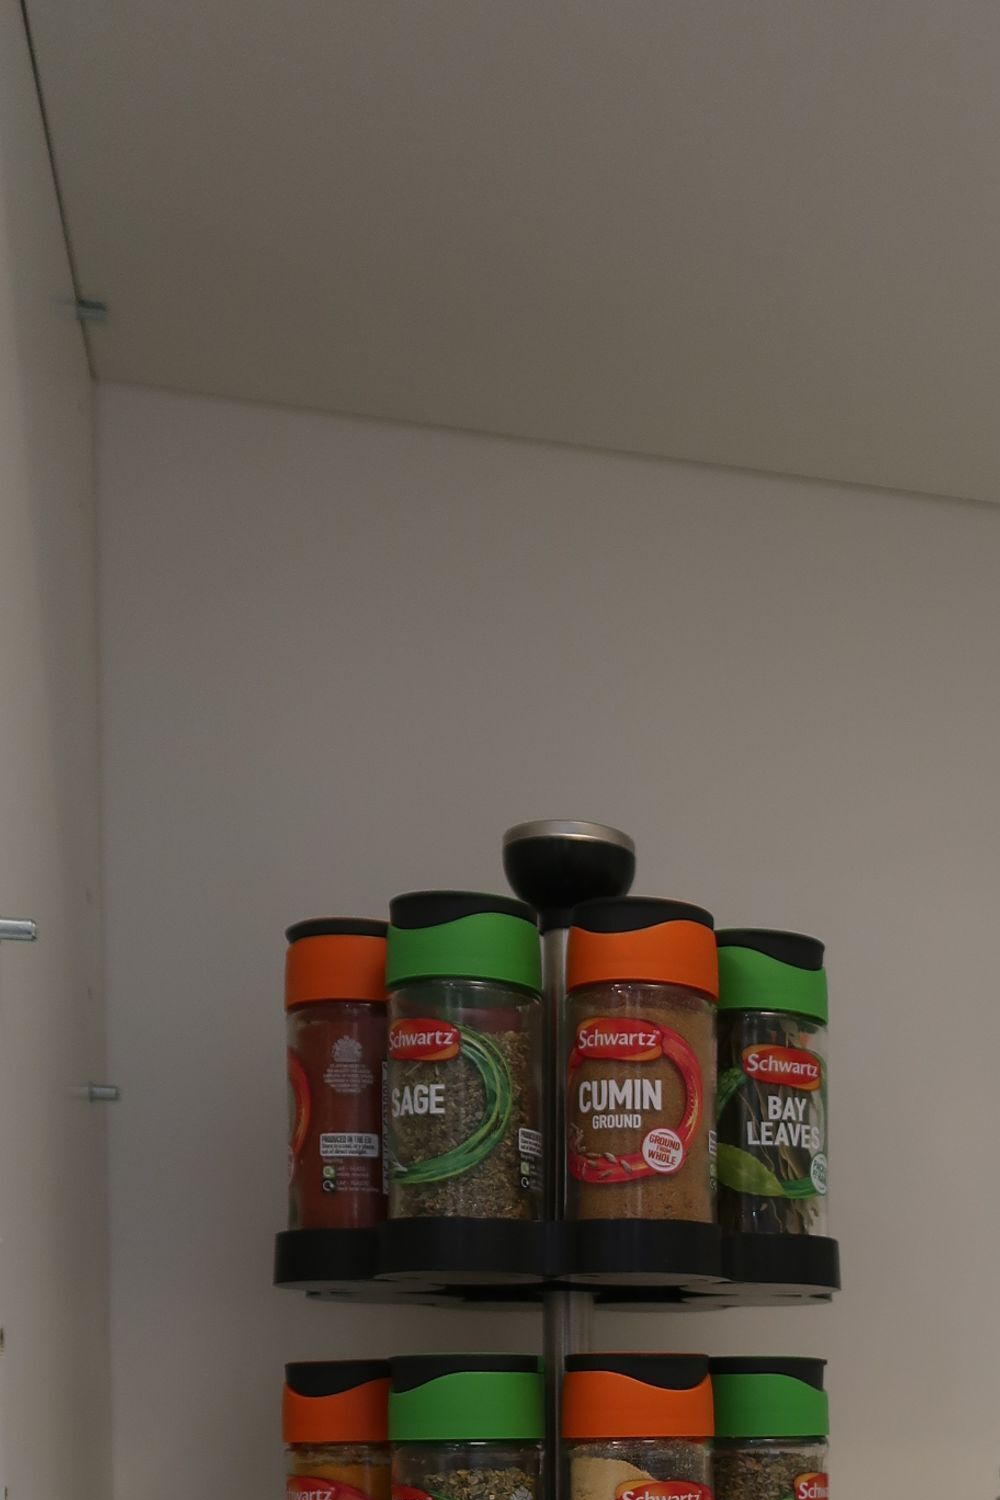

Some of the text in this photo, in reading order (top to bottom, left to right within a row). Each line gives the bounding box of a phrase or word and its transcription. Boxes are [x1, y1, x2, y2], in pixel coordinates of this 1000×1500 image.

[389, 1030, 454, 1051] Schwartz
[578, 1029, 656, 1049] Schwartz
[747, 1053, 818, 1077] Schwartz
[392, 1084, 446, 1117] SAGE
[579, 1079, 662, 1113] CUMIN
[767, 1095, 807, 1121] BAY
[592, 1114, 642, 1129] GROUND
[649, 1133, 681, 1151] GROUND
[747, 1121, 820, 1149] LEAVES
[648, 1149, 677, 1166] WHOLE
